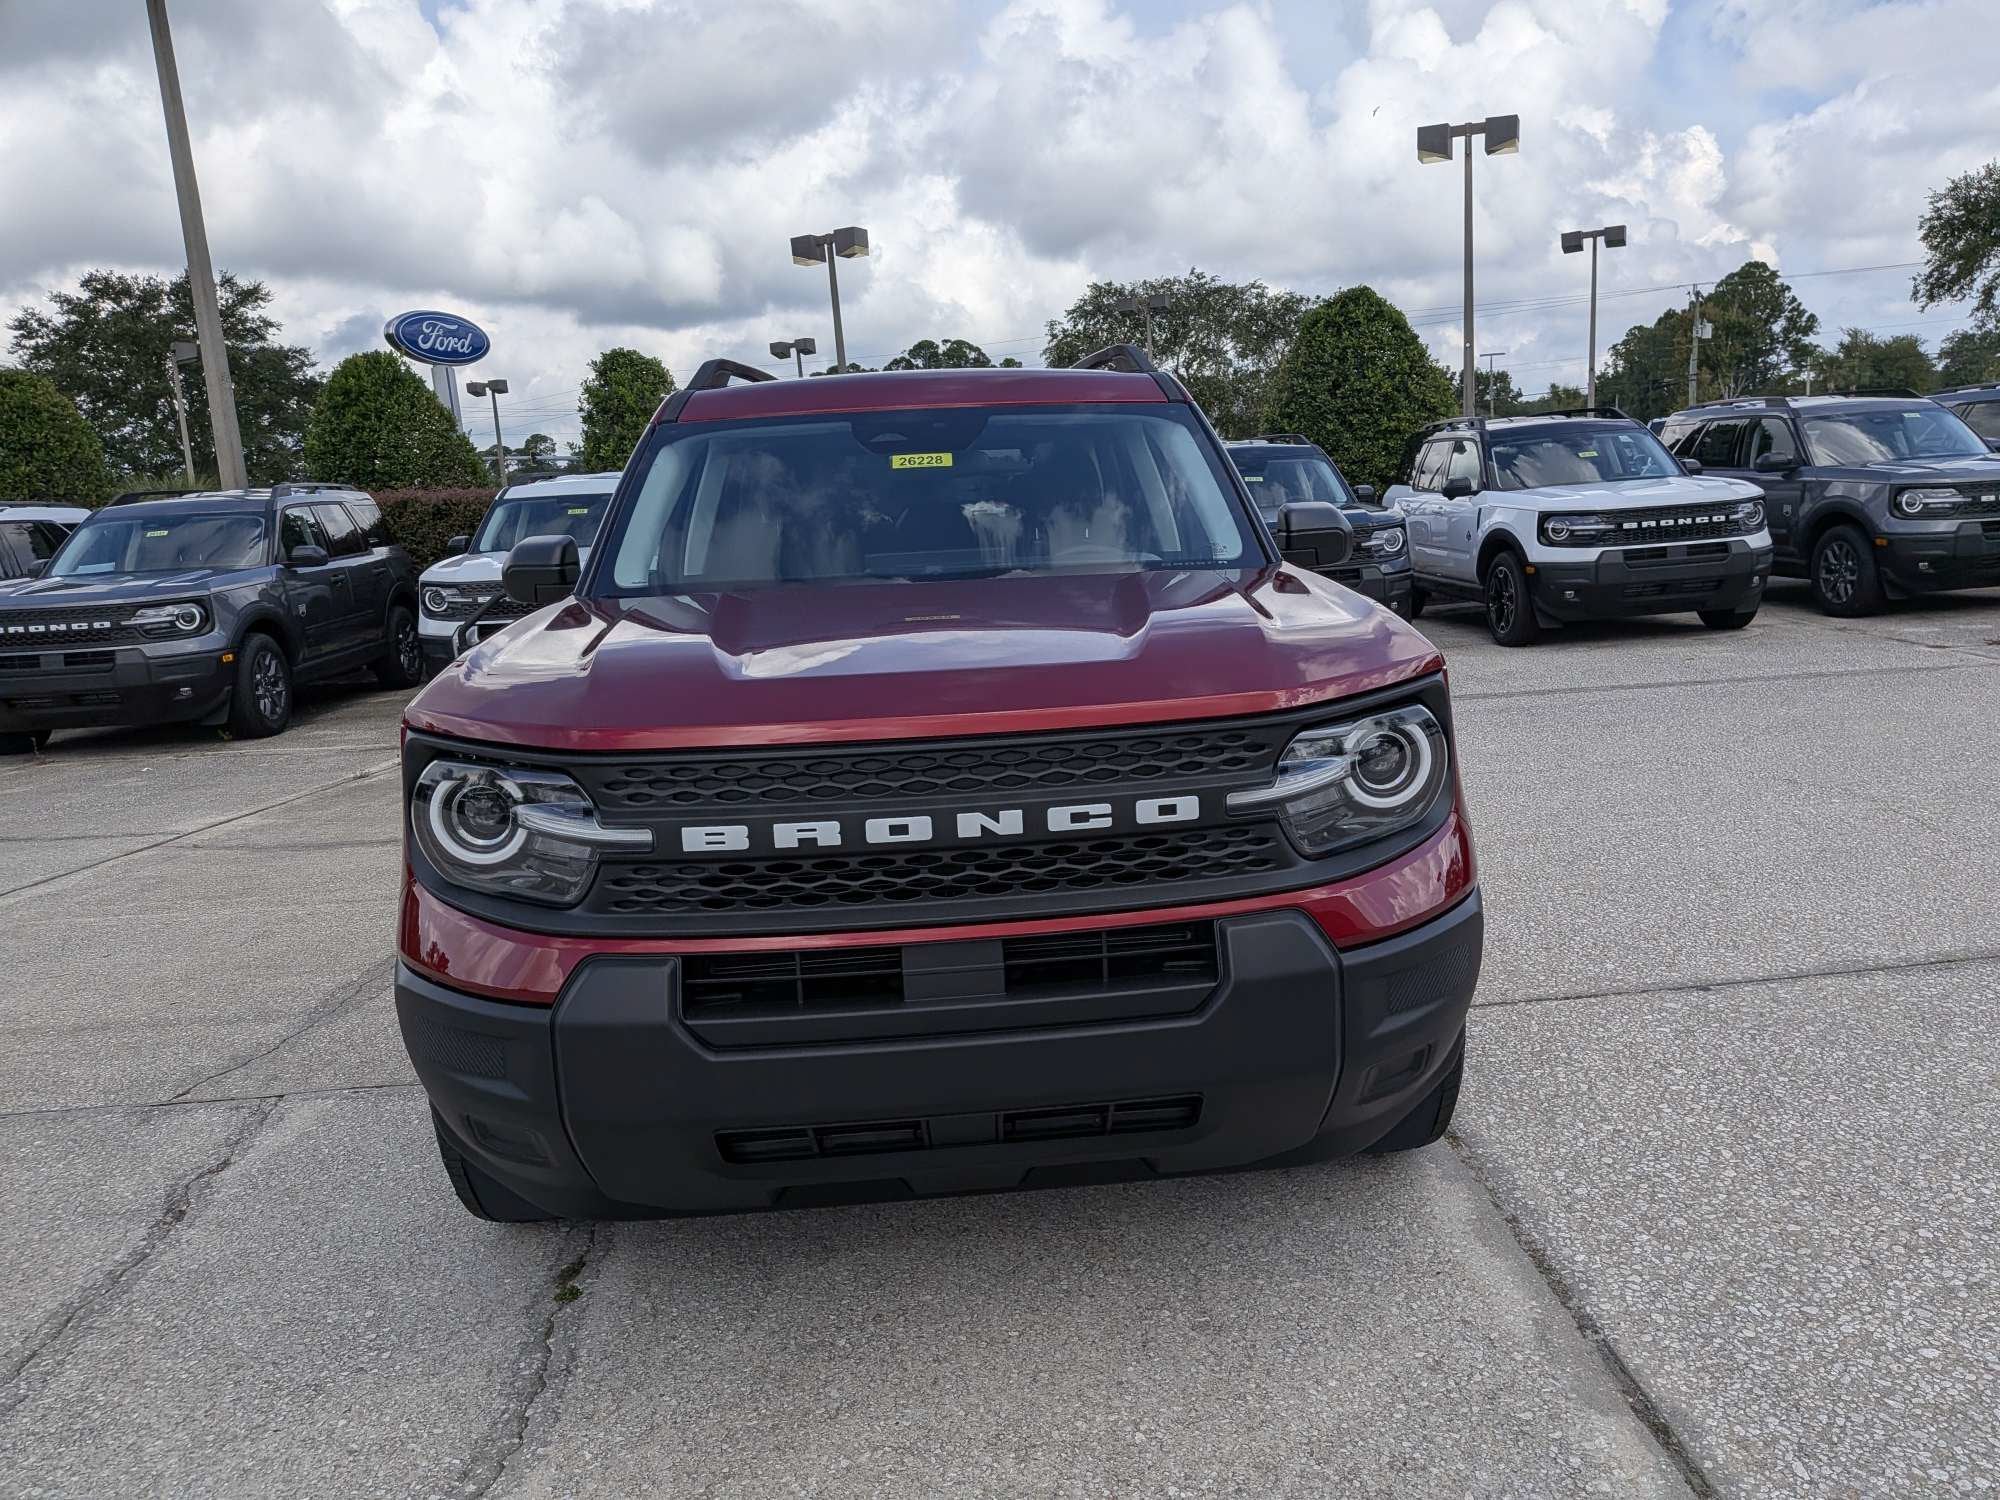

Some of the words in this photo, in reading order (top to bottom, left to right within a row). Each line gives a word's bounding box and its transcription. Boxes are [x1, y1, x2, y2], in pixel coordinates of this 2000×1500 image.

[418, 320, 472, 354] Ford
[899, 455, 943, 466] 26228
[1622, 515, 1726, 530] BRONCO
[0, 621, 112, 634] RONCO
[681, 795, 1200, 853] BRONCO
